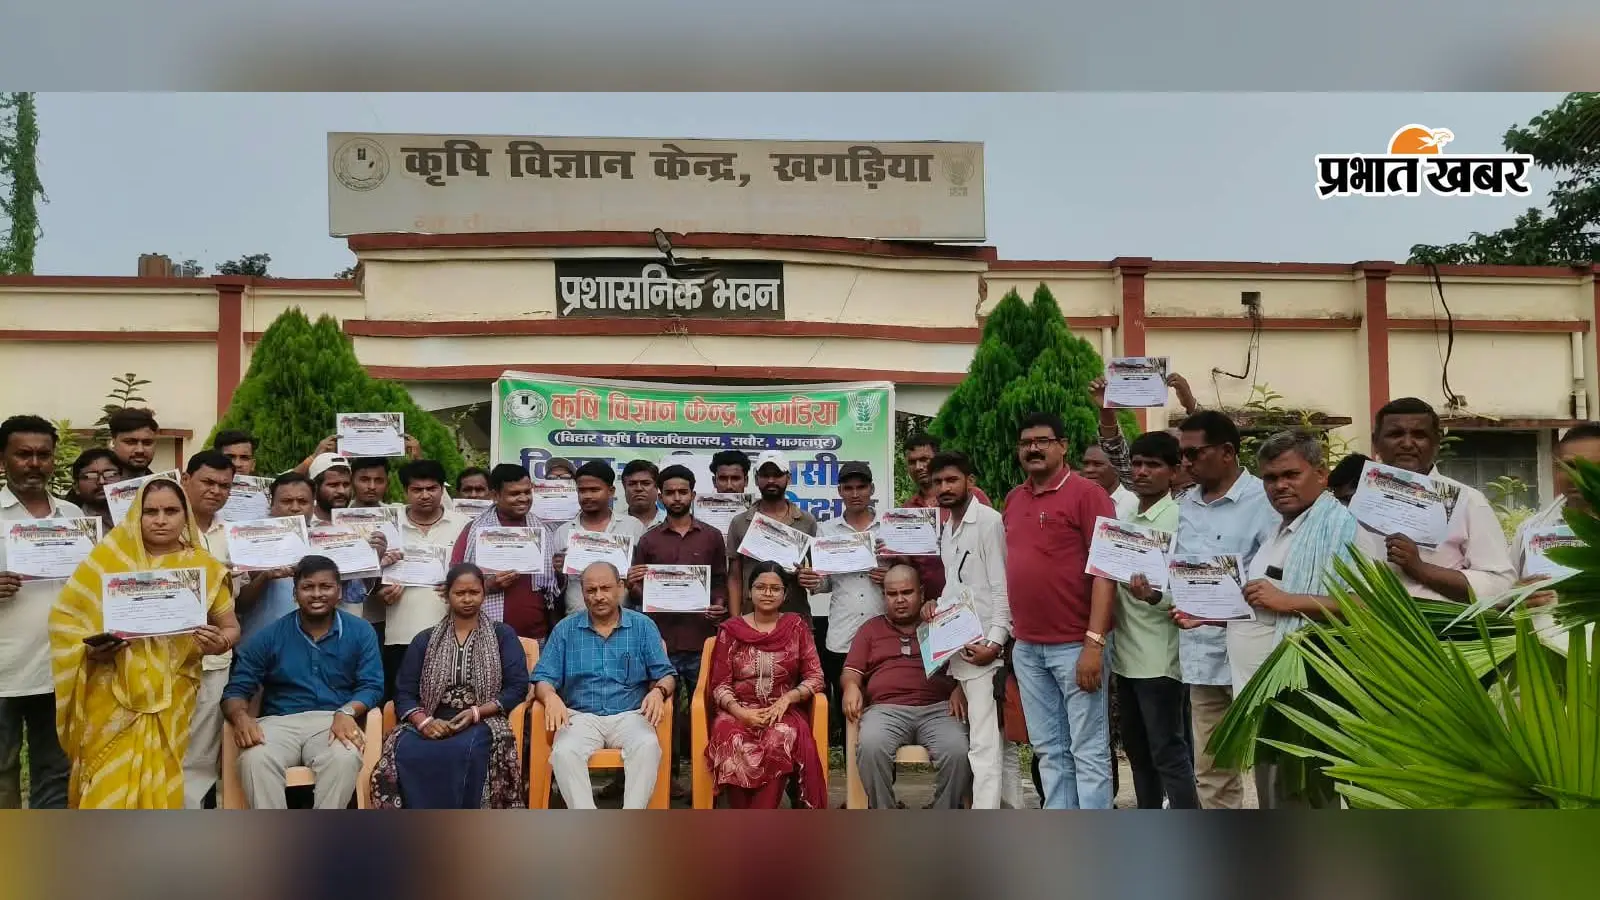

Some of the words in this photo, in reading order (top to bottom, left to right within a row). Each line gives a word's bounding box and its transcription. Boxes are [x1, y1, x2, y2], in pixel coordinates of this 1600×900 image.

[400, 139, 492, 186] कृषि
[505, 141, 636, 179] विज्ञान
[649, 144, 750, 187] केन्द्र,
[769, 146, 934, 189] खगड़िया
[560, 263, 705, 316] प्रशासनिक
[713, 278, 780, 310] भवन
[551, 389, 601, 428] कृषि
[608, 391, 677, 424] विज्ञान
[749, 395, 841, 430] खगड़िया
[554, 431, 597, 444] (बिहार
[601, 431, 631, 446] कृषि
[776, 437, 837, 448] भागलपुर)
